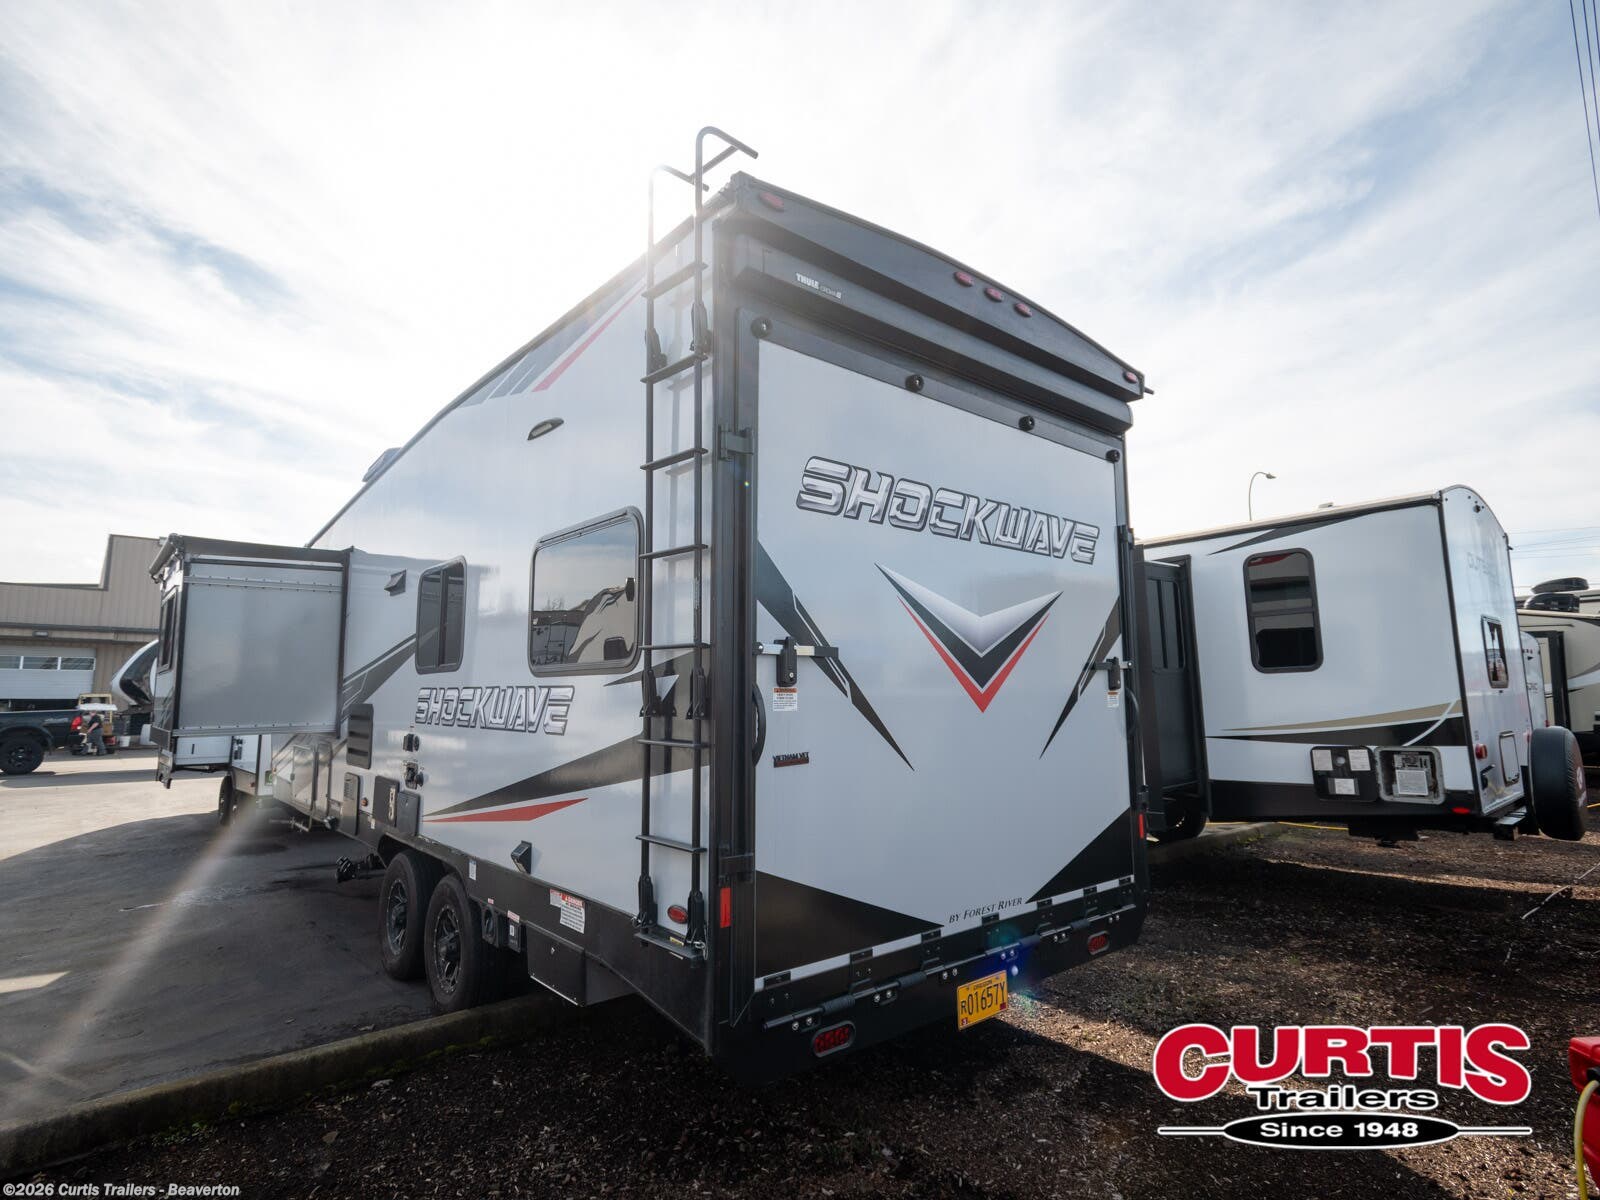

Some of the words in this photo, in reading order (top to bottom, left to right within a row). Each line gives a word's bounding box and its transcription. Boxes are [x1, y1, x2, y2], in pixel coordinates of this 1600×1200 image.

[796, 455, 1100, 565] SHOCKWAVE
[415, 685, 575, 736] SHOCKWAVE
[949, 913, 962, 923] BY
[963, 904, 996, 920] FOREST
[998, 897, 1022, 910] RIVER
